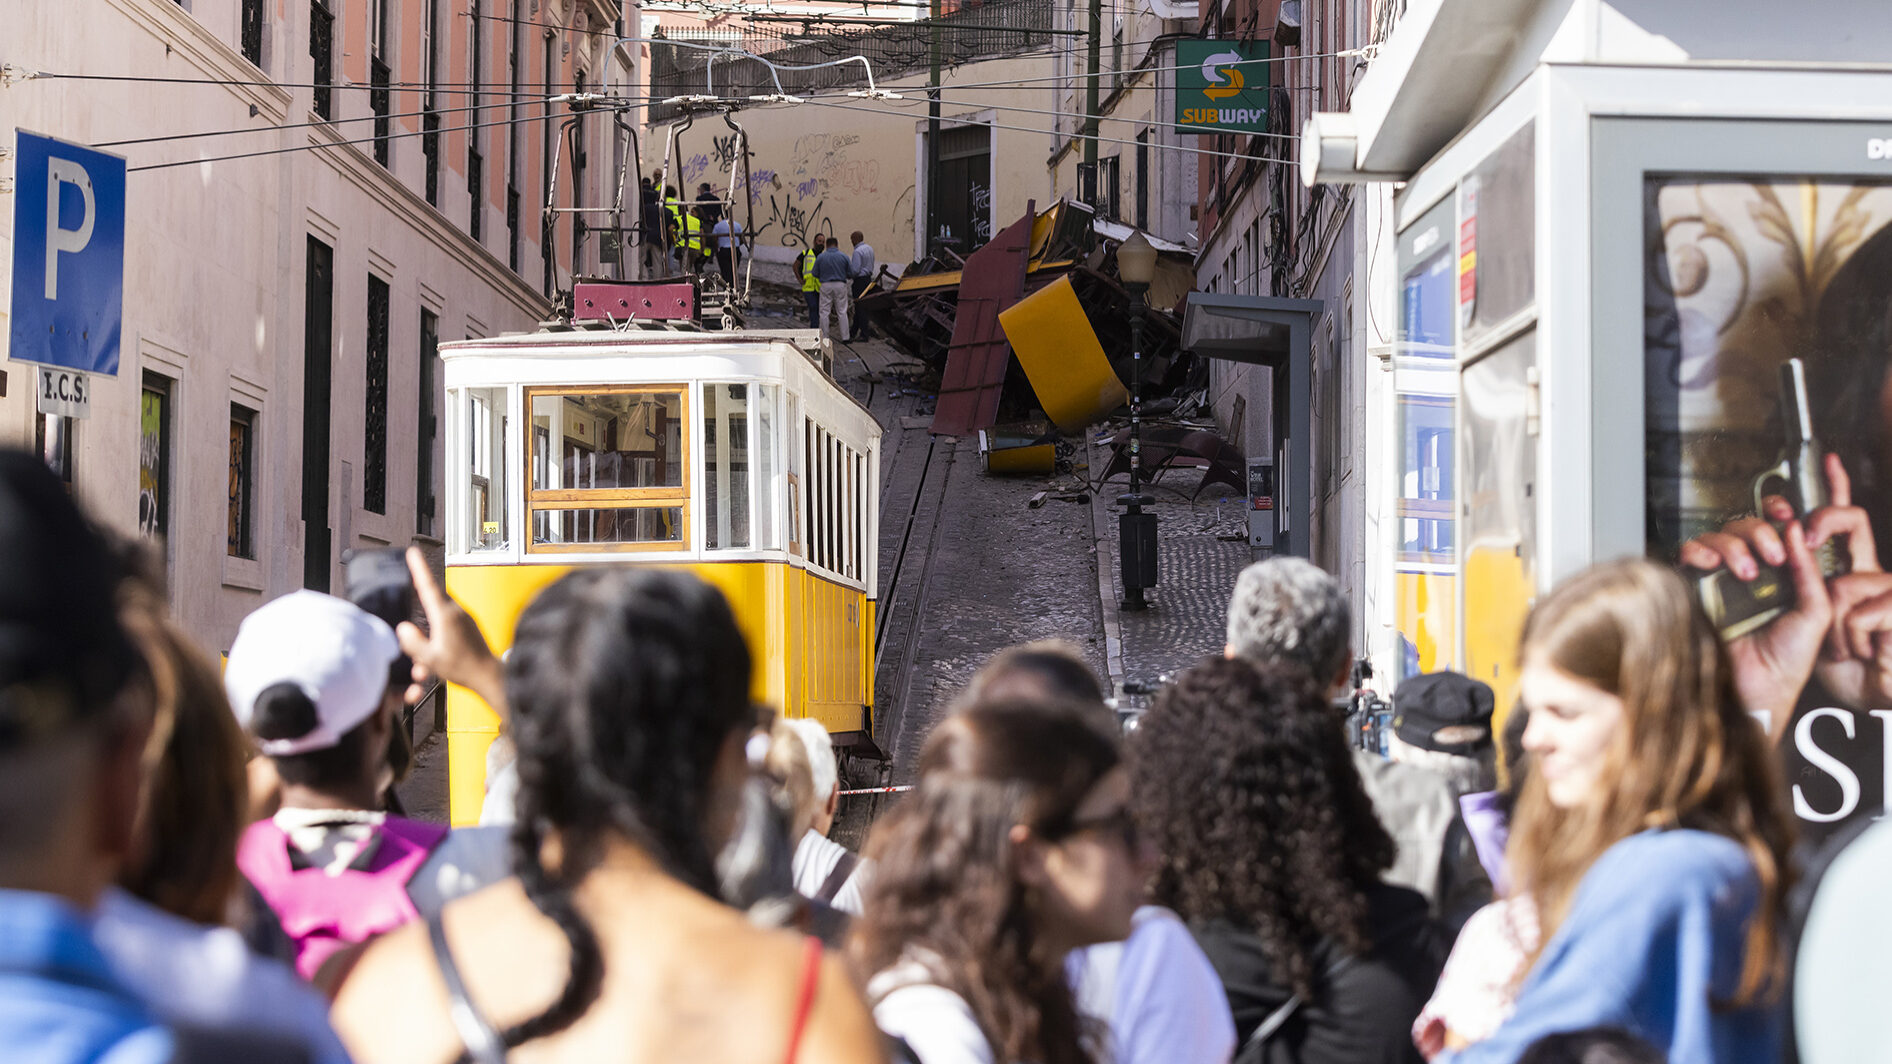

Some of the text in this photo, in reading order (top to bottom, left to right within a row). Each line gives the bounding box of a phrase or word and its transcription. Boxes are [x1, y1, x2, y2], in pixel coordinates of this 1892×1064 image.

[1180, 108, 1266, 124] SUBWAY
[45, 156, 96, 300] P
[44, 371, 87, 404] I.C.S.
